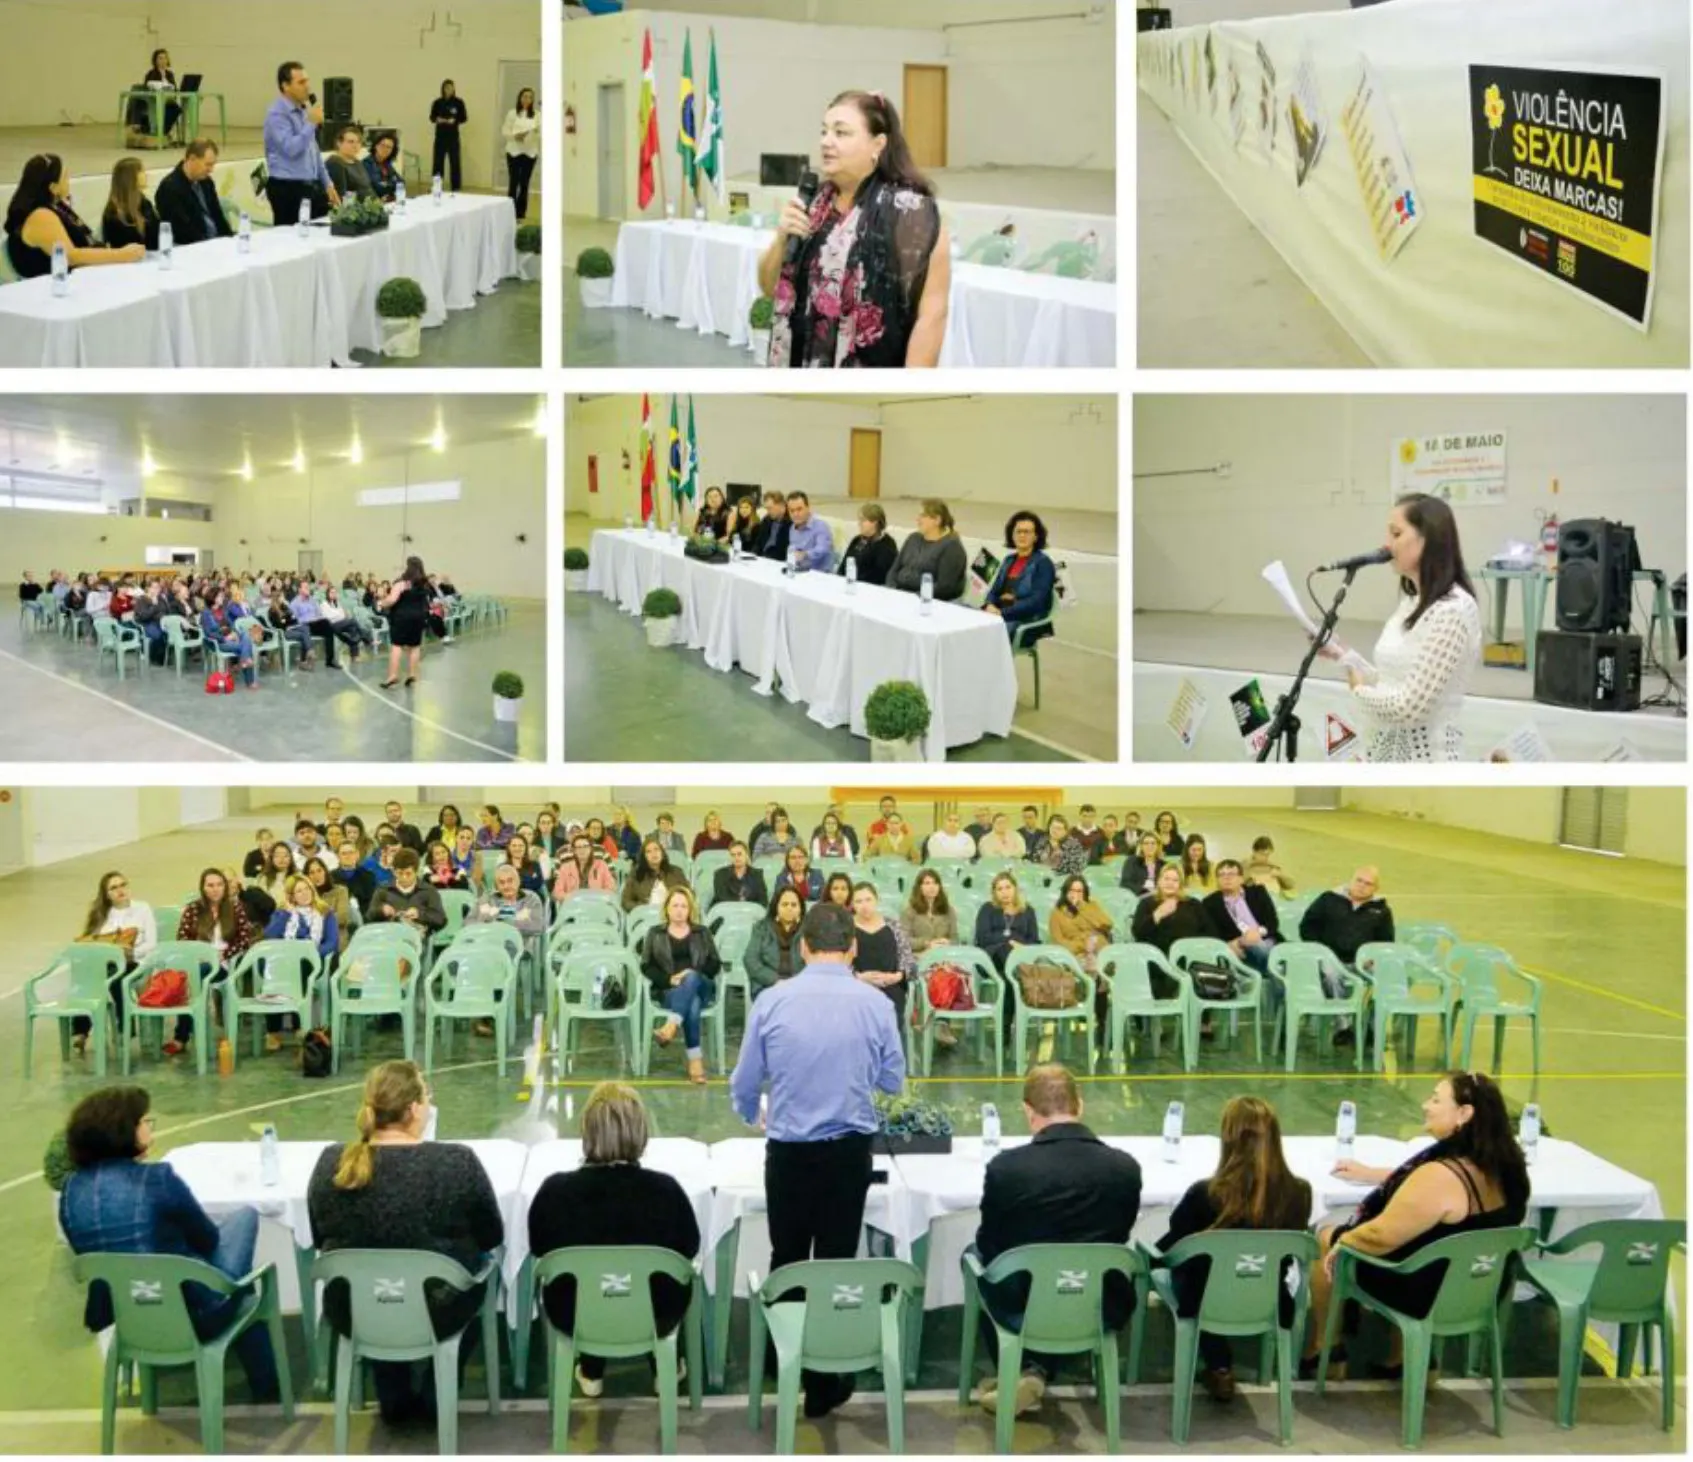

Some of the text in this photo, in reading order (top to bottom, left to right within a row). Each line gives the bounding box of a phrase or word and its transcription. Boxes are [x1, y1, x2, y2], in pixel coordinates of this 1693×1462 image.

[1512, 88, 1627, 140] VIOLÊNCIA
[1512, 122, 1624, 190] SEXUAL
[1514, 165, 1551, 198] DEIXA
[1553, 178, 1624, 222] MARCAS!
[1444, 437, 1462, 451] DE
[1465, 433, 1504, 449] MAIO
